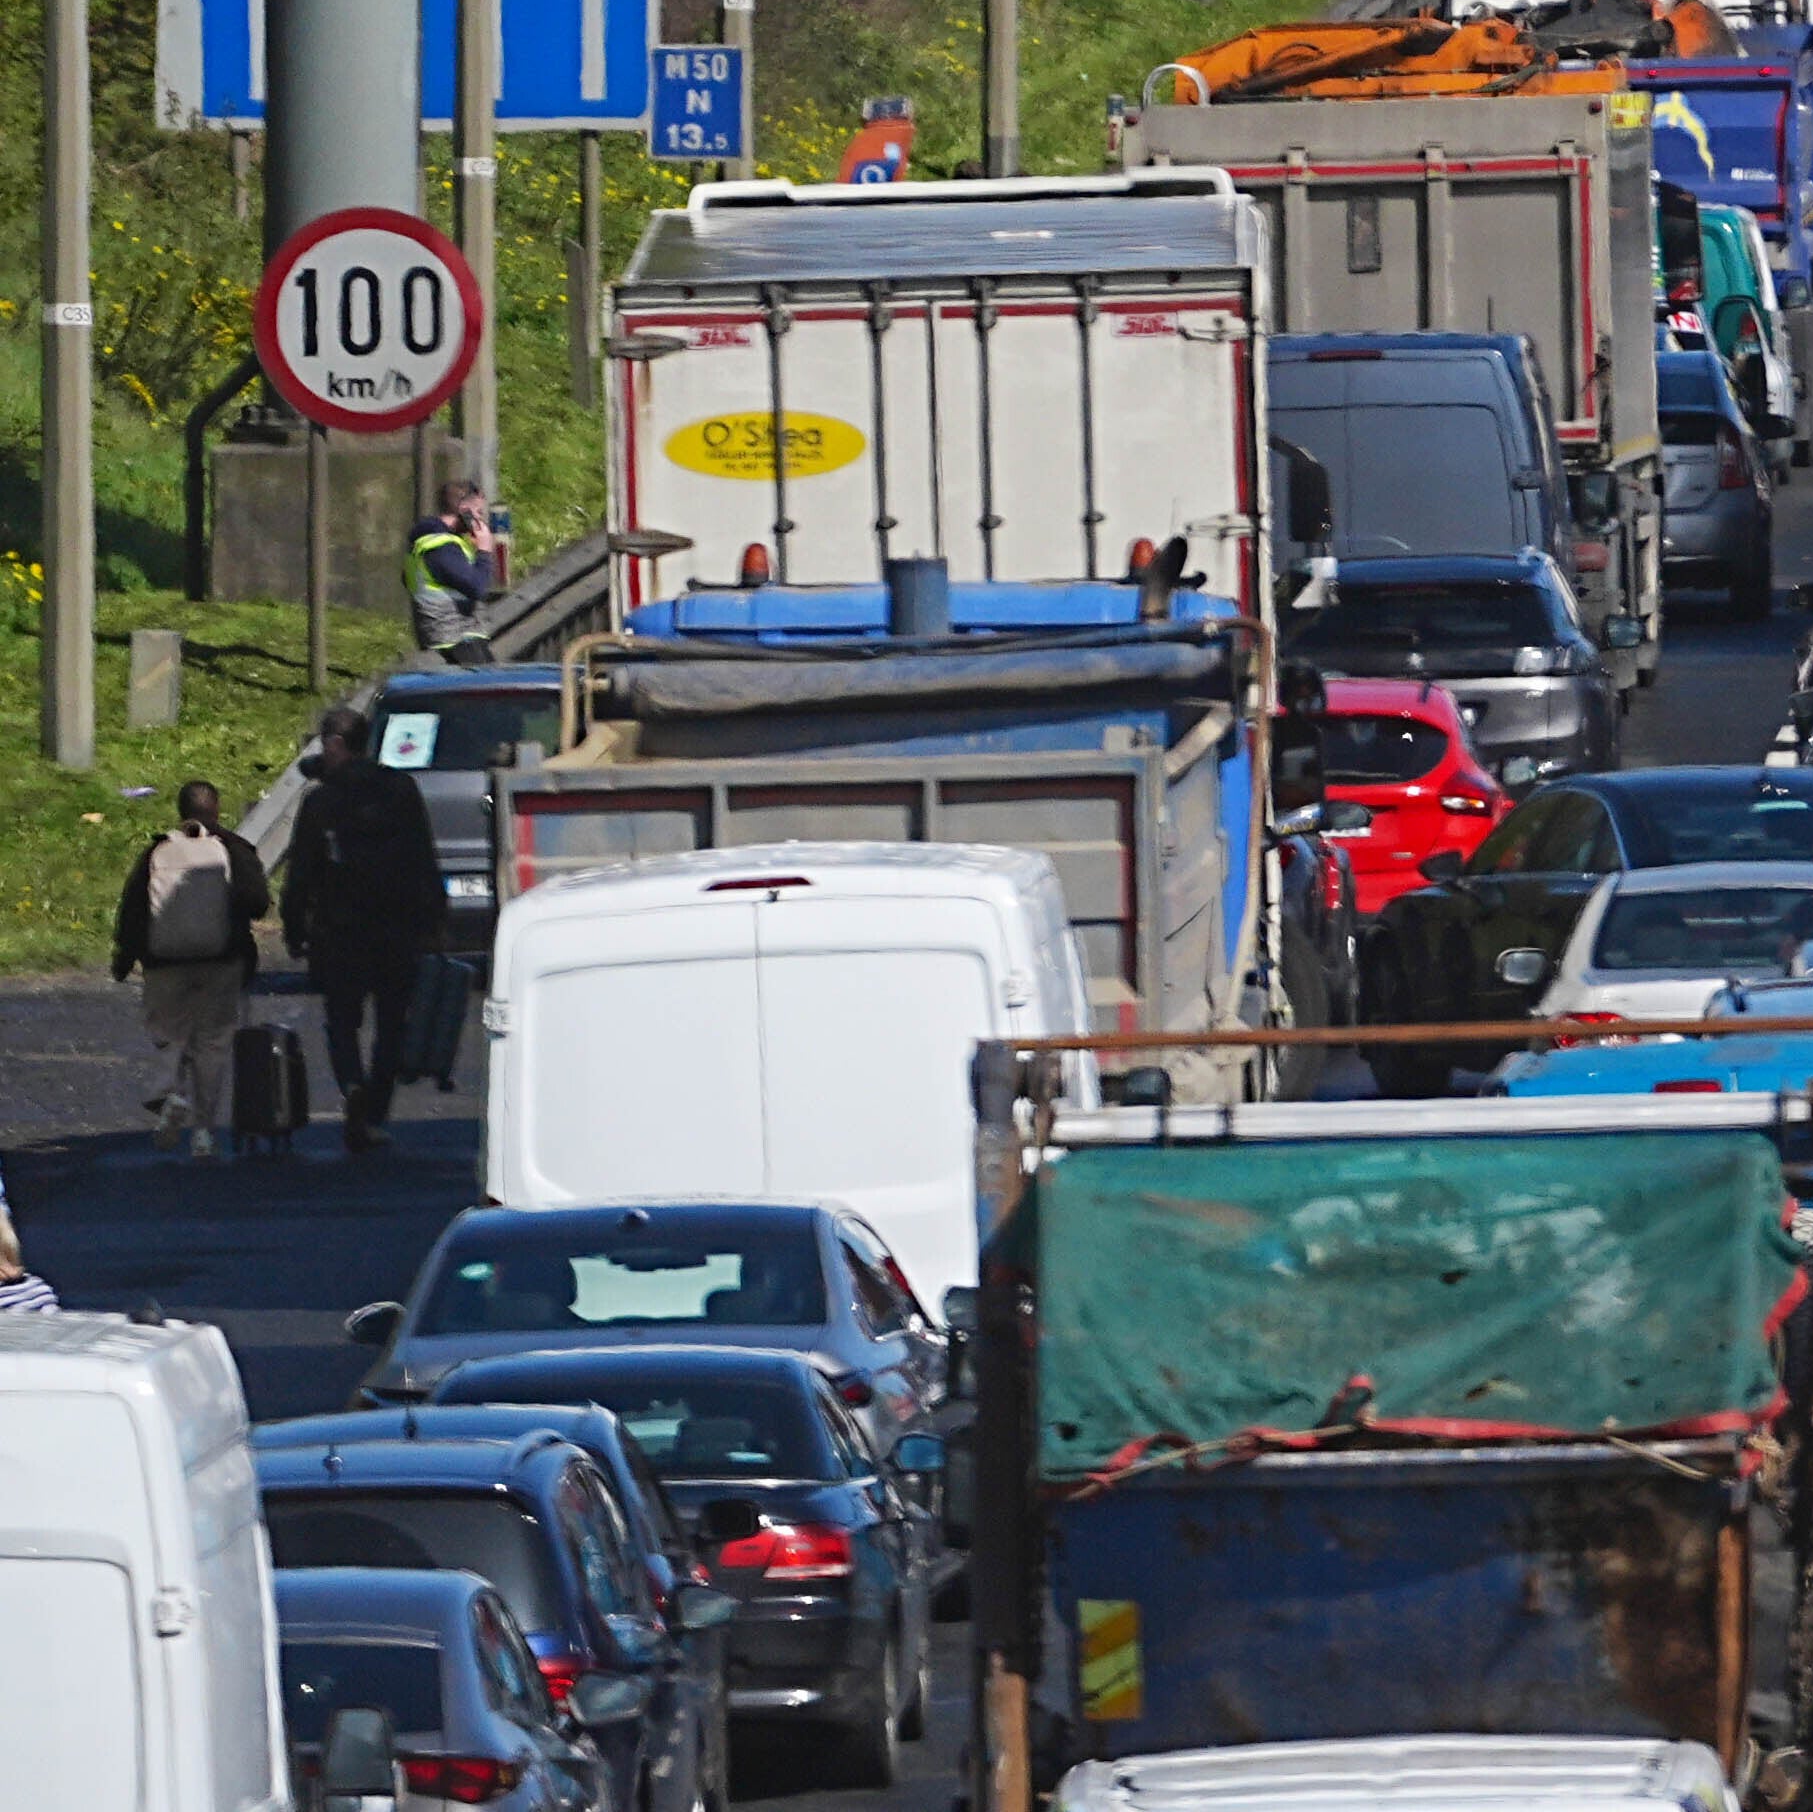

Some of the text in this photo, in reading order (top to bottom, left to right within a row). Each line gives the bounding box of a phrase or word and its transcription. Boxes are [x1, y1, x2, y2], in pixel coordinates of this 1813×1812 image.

[686, 89, 712, 114] N
[666, 123, 728, 150] 13.5
[295, 266, 443, 356] 100
[327, 367, 412, 400] km/h
